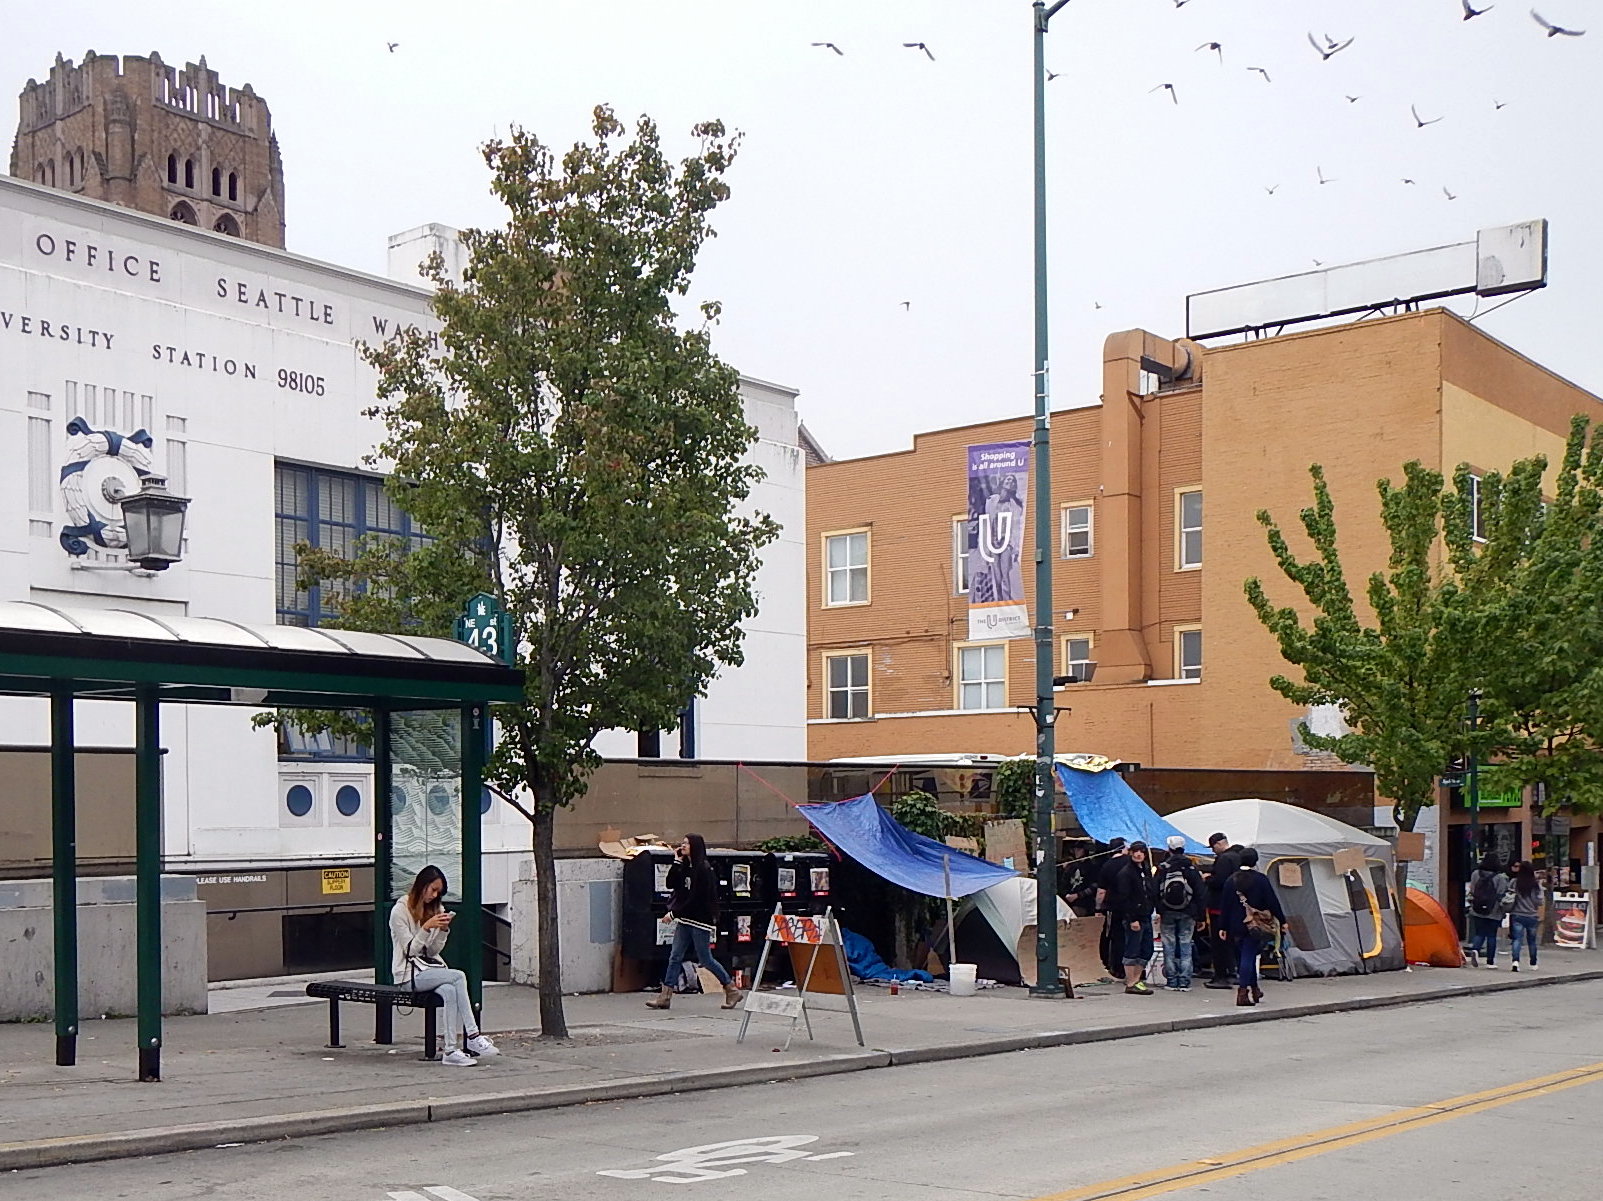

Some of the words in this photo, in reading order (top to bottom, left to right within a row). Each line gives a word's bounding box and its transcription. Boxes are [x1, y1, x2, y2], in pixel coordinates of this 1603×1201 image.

[36, 233, 161, 283] OFFICE
[217, 278, 334, 325] SEATTLE
[152, 344, 257, 380] STATION
[277, 368, 325, 397] 98105
[980, 451, 1015, 461] Shopping
[979, 461, 988, 470] all
[990, 459, 1016, 469] around
[465, 618, 476, 628] NE
[218, 875, 232, 884] USE
[233, 874, 267, 883] HANDRAILS
[324, 870, 350, 879] CAUTION
